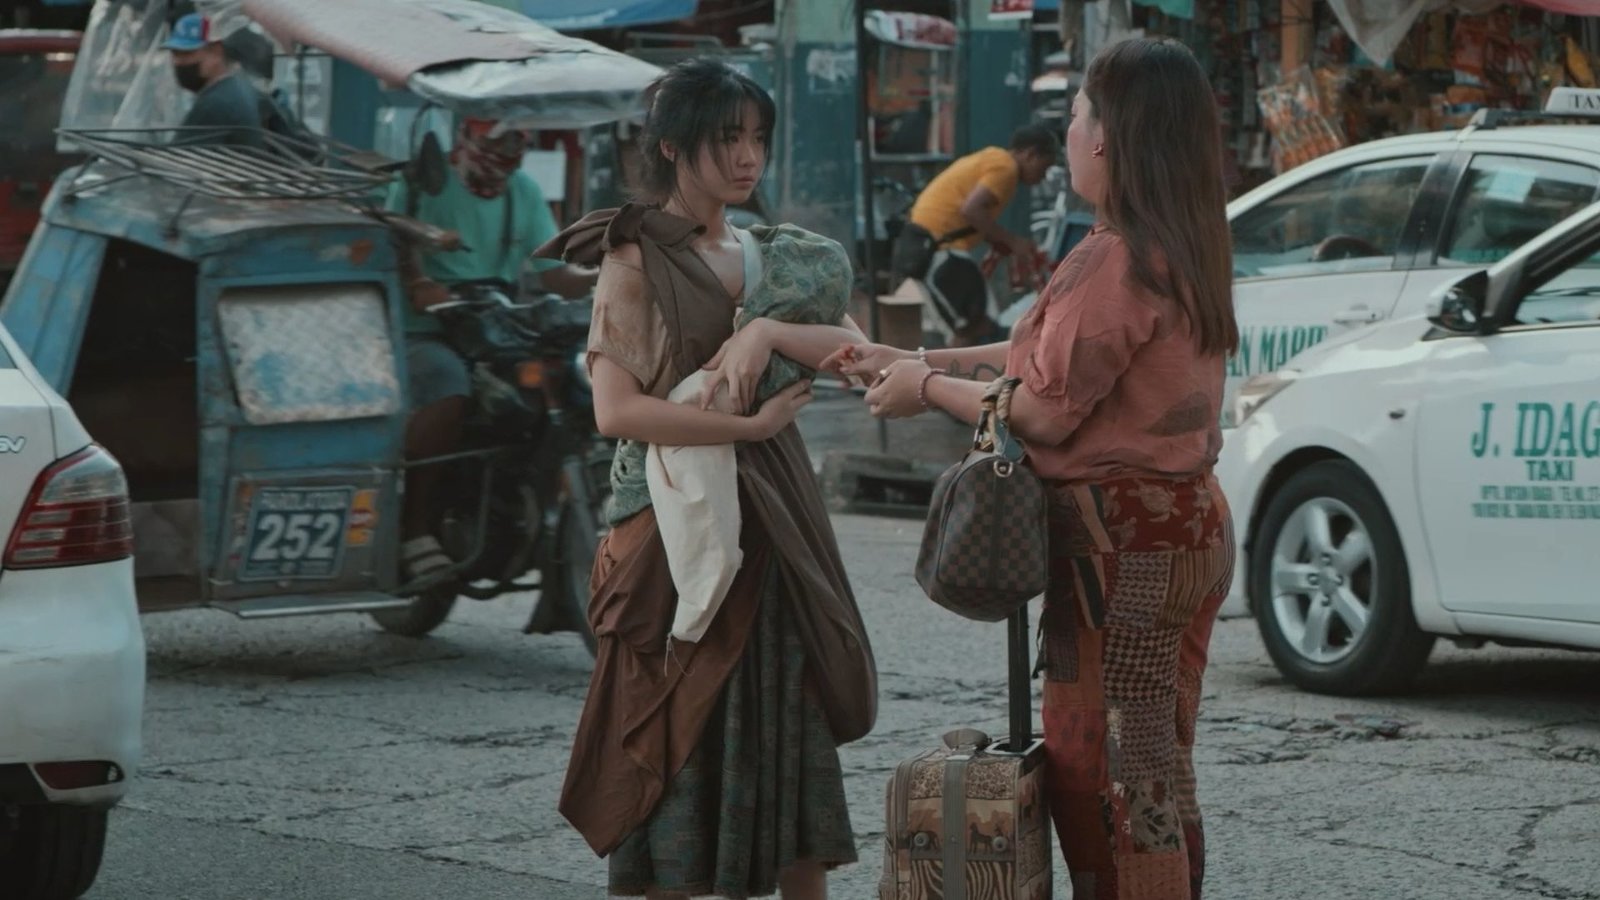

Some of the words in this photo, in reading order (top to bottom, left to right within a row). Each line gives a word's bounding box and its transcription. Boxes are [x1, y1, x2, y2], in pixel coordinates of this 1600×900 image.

[1569, 94, 1600, 109] TA
[1471, 402, 1499, 458] J.
[1524, 460, 1574, 481] TAXI
[252, 513, 340, 560] 252
